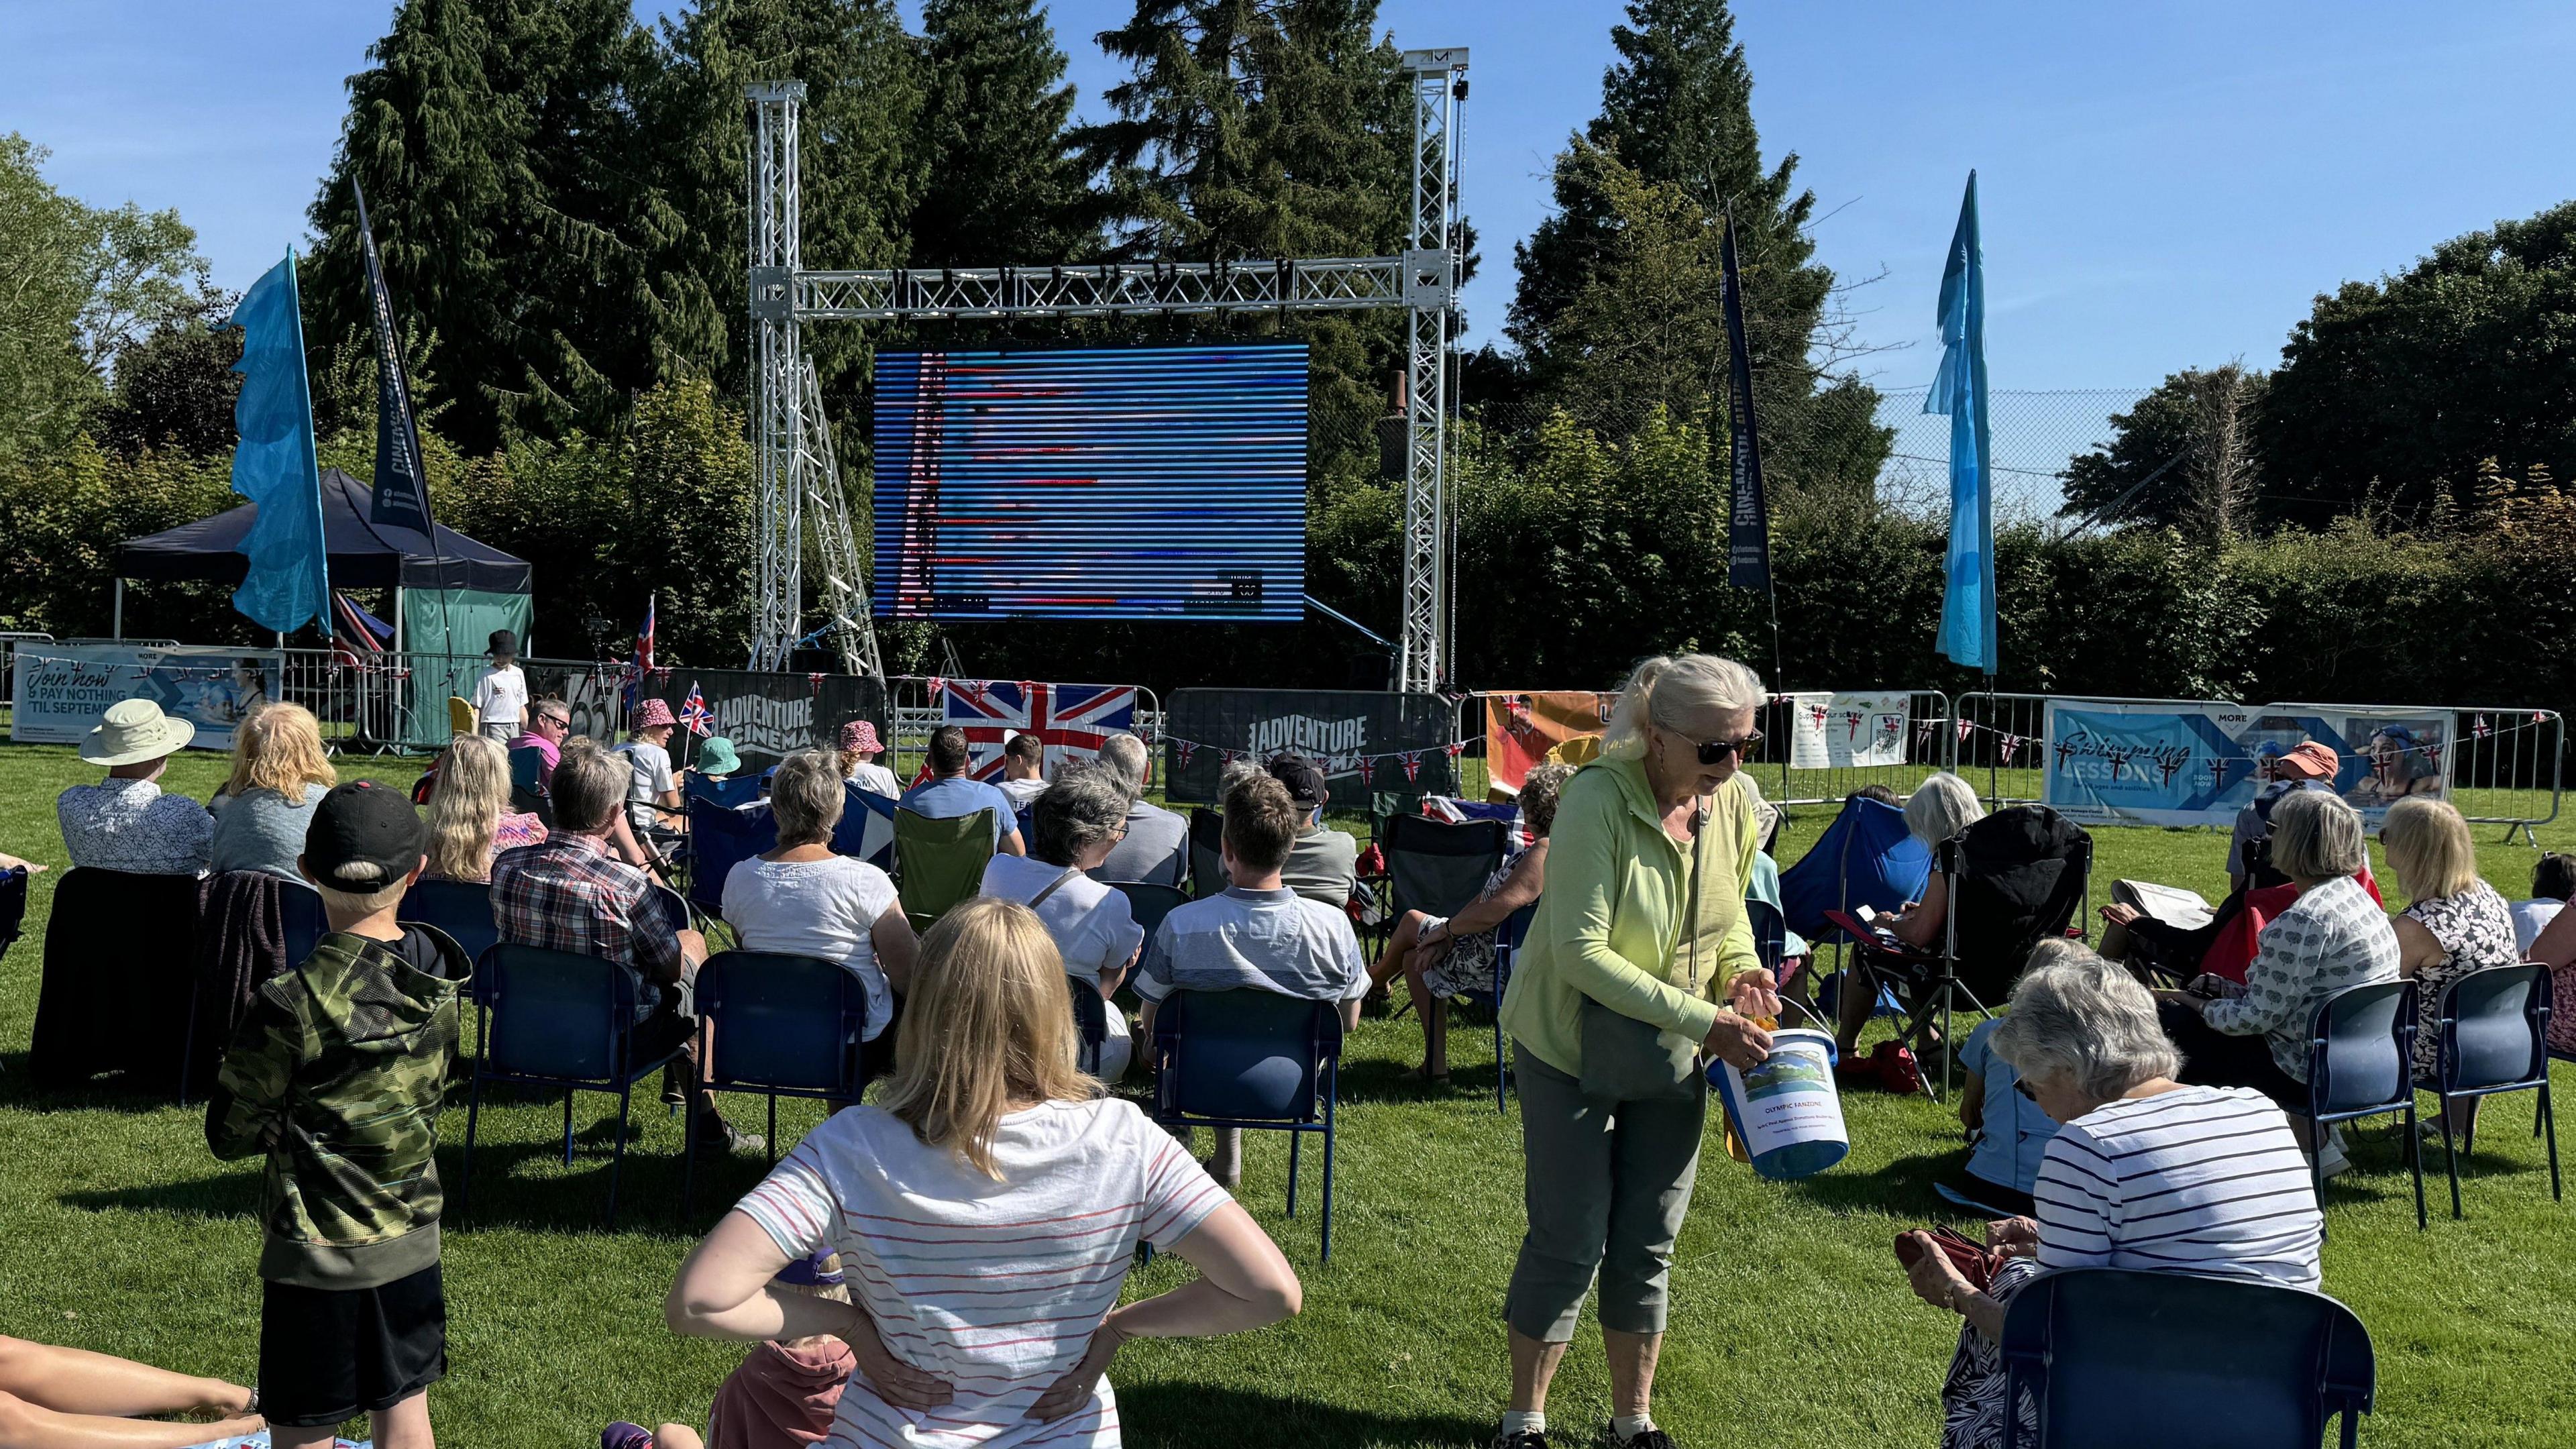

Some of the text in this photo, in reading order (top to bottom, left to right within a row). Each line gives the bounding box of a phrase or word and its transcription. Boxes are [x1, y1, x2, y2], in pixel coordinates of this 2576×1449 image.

[28, 688, 36, 698] &
[40, 687, 63, 699] PAY
[67, 689, 126, 702] NOTHING
[720, 694, 814, 731] ADVENTURE
[729, 723, 812, 750] CINEMA
[1258, 714, 1367, 752] ADVENTURE
[1765, 1103, 1792, 1114] OLYMPIC
